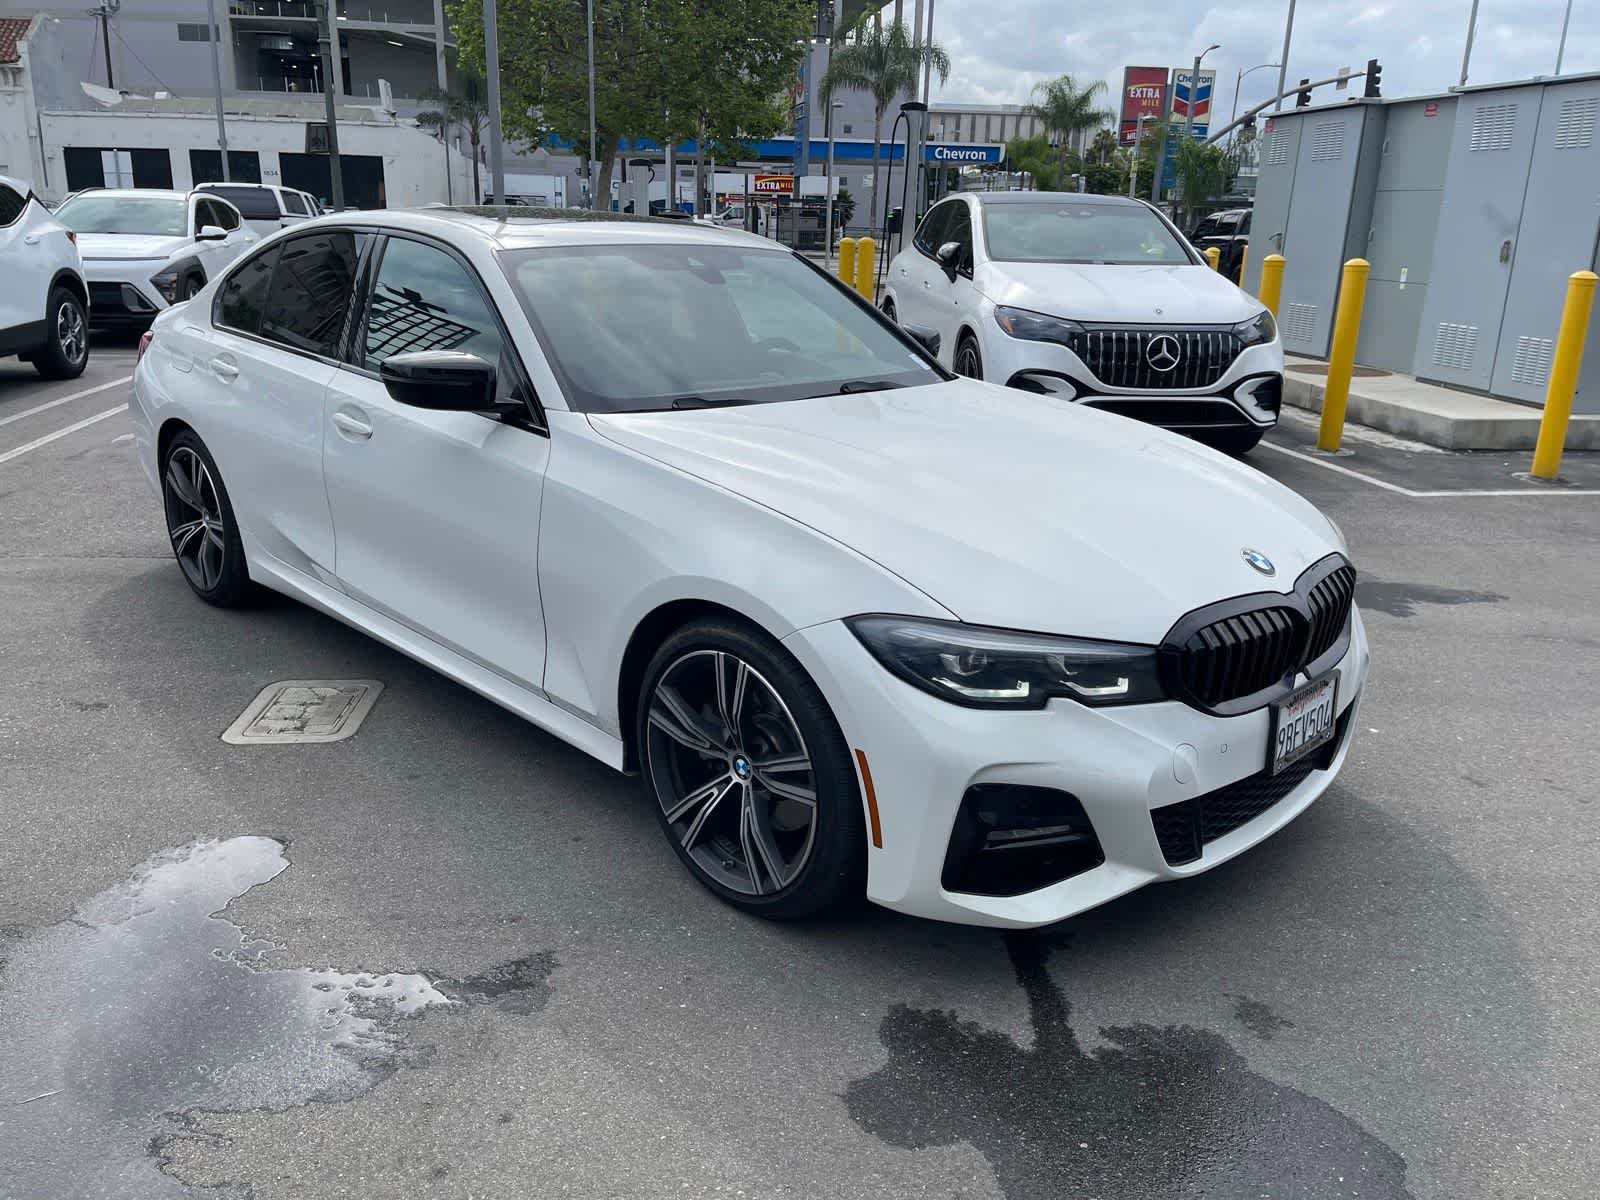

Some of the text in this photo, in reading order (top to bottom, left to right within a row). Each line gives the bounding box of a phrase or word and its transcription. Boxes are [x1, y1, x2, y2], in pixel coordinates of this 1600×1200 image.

[1177, 73, 1213, 83] Cheron
[1129, 87, 1160, 98] EXTRA
[1141, 98, 1160, 107] MILE
[934, 146, 987, 161] Chevron
[756, 181, 780, 190] EXTRA
